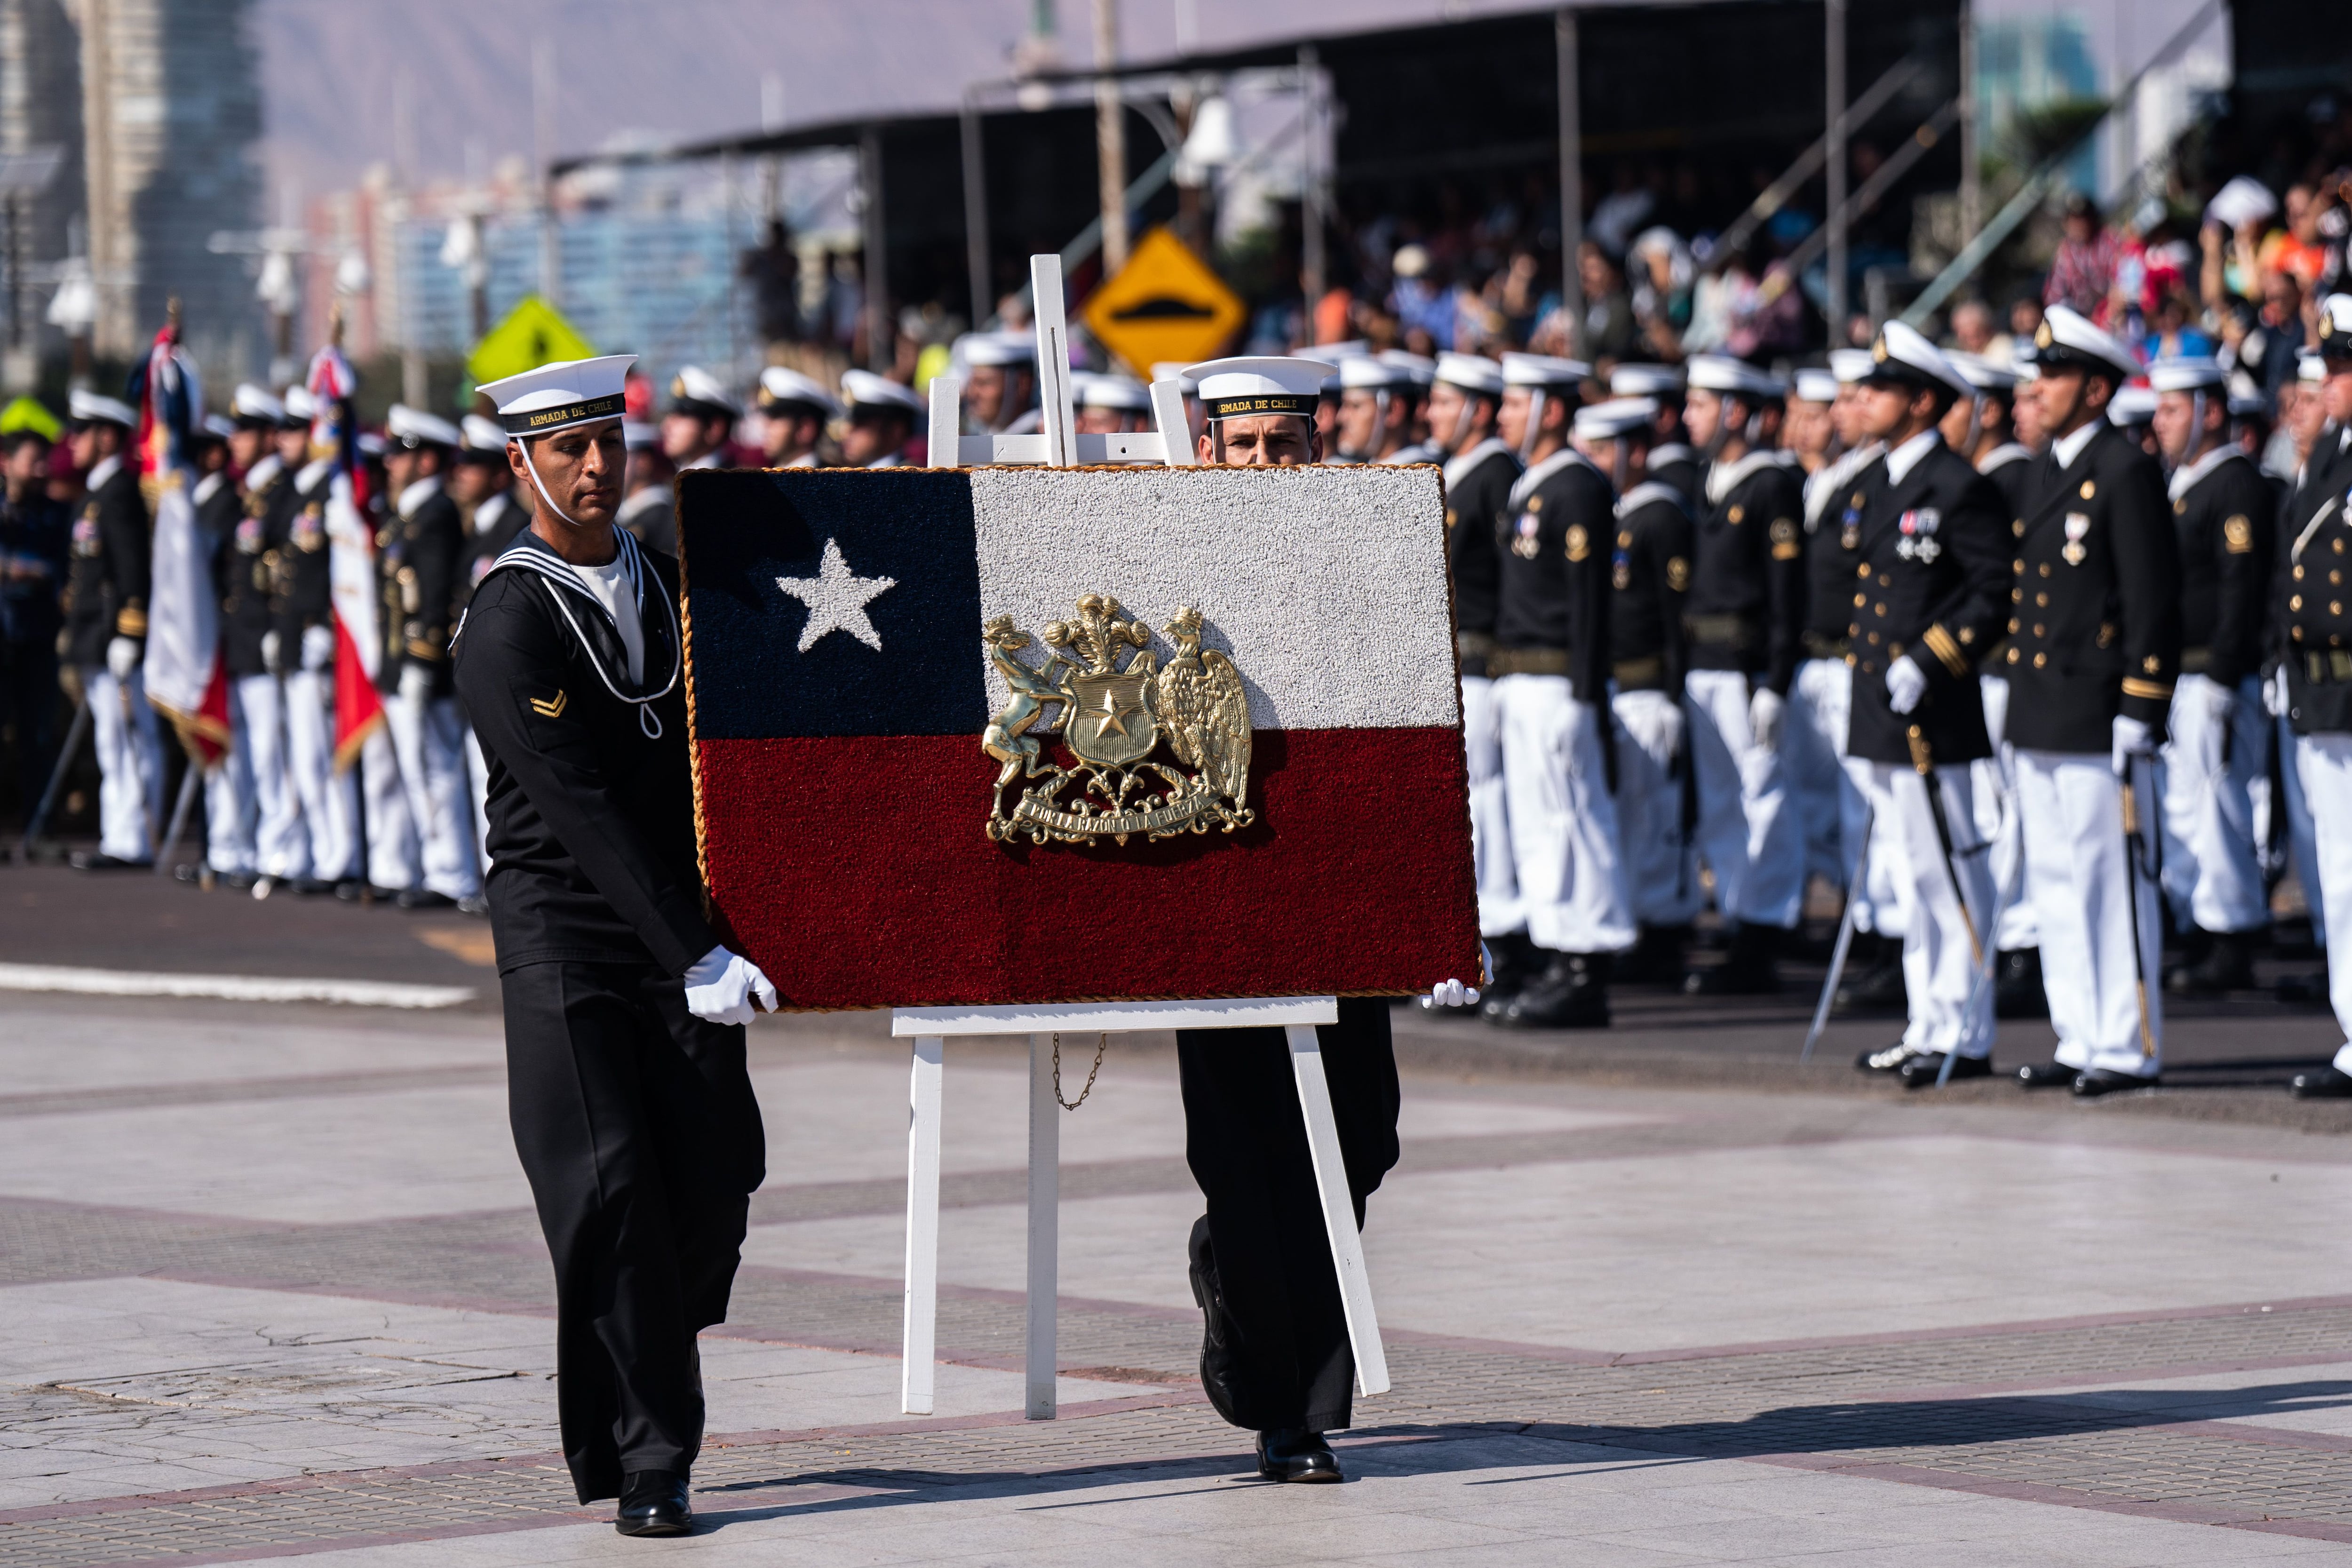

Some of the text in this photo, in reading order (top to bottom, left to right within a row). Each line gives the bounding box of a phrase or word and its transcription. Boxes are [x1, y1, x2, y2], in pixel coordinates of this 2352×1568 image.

[530, 401, 612, 426] ARMADA DE CHILE
[1216, 399, 1297, 414] ARMADA DE CHILE
[1030, 795, 1205, 832] POR LA RAZON O LA FUERZA
